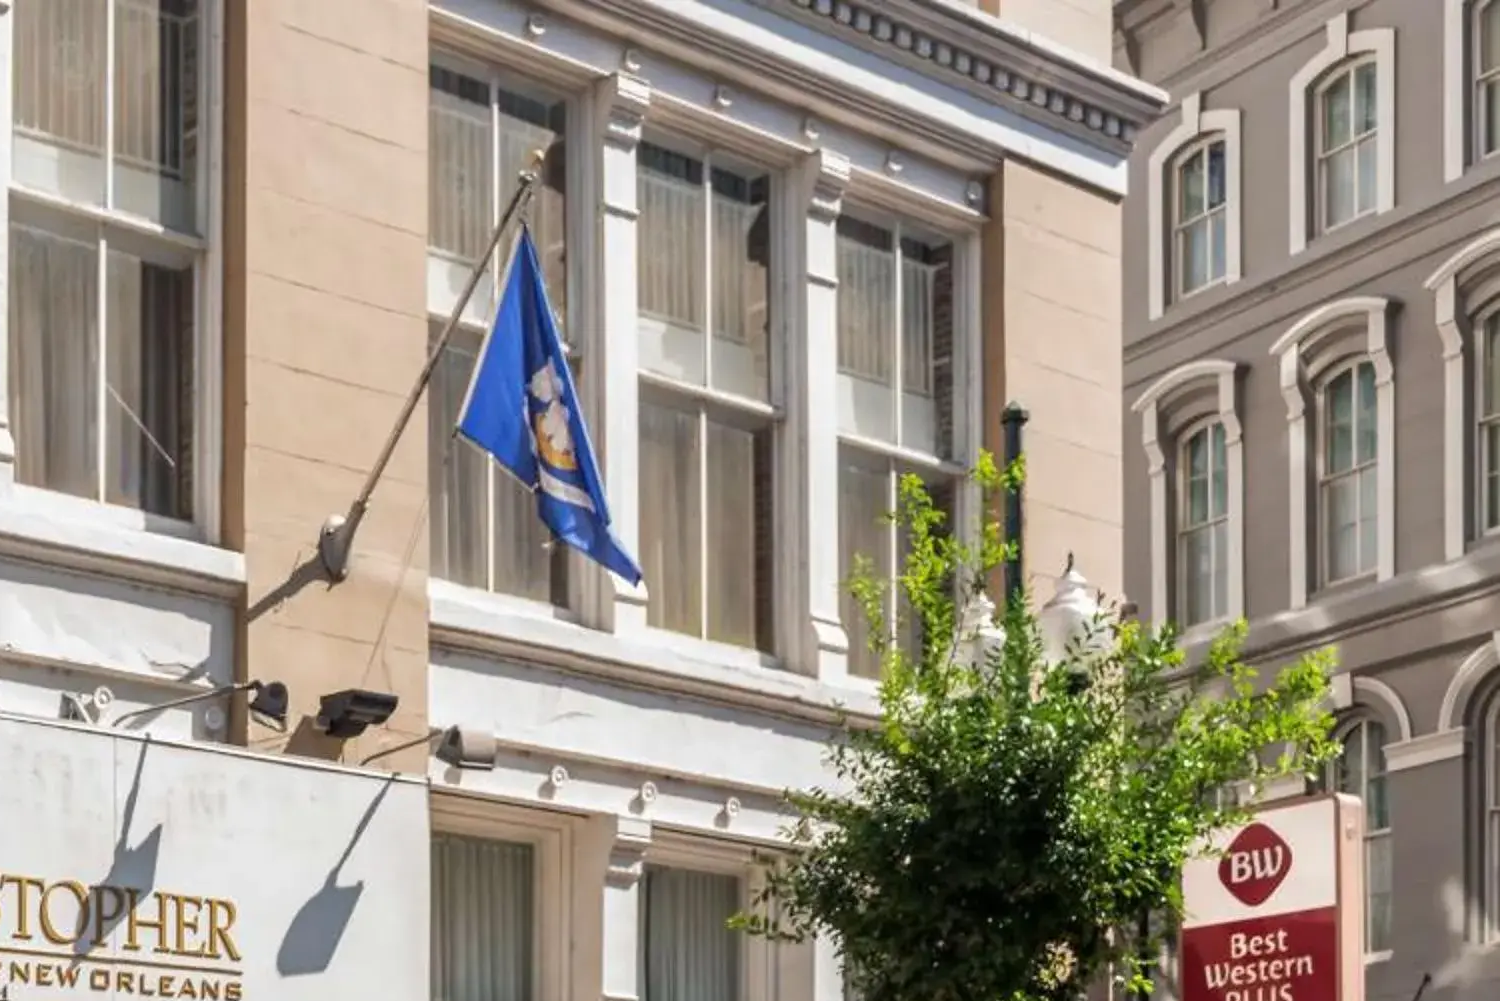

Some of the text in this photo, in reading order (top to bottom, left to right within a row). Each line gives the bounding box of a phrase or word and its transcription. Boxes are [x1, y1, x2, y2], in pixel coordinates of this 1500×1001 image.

[1231, 845, 1283, 884] BW
[1231, 928, 1288, 959] Best
[9, 960, 80, 988] NEW
[1204, 954, 1313, 990] Western
